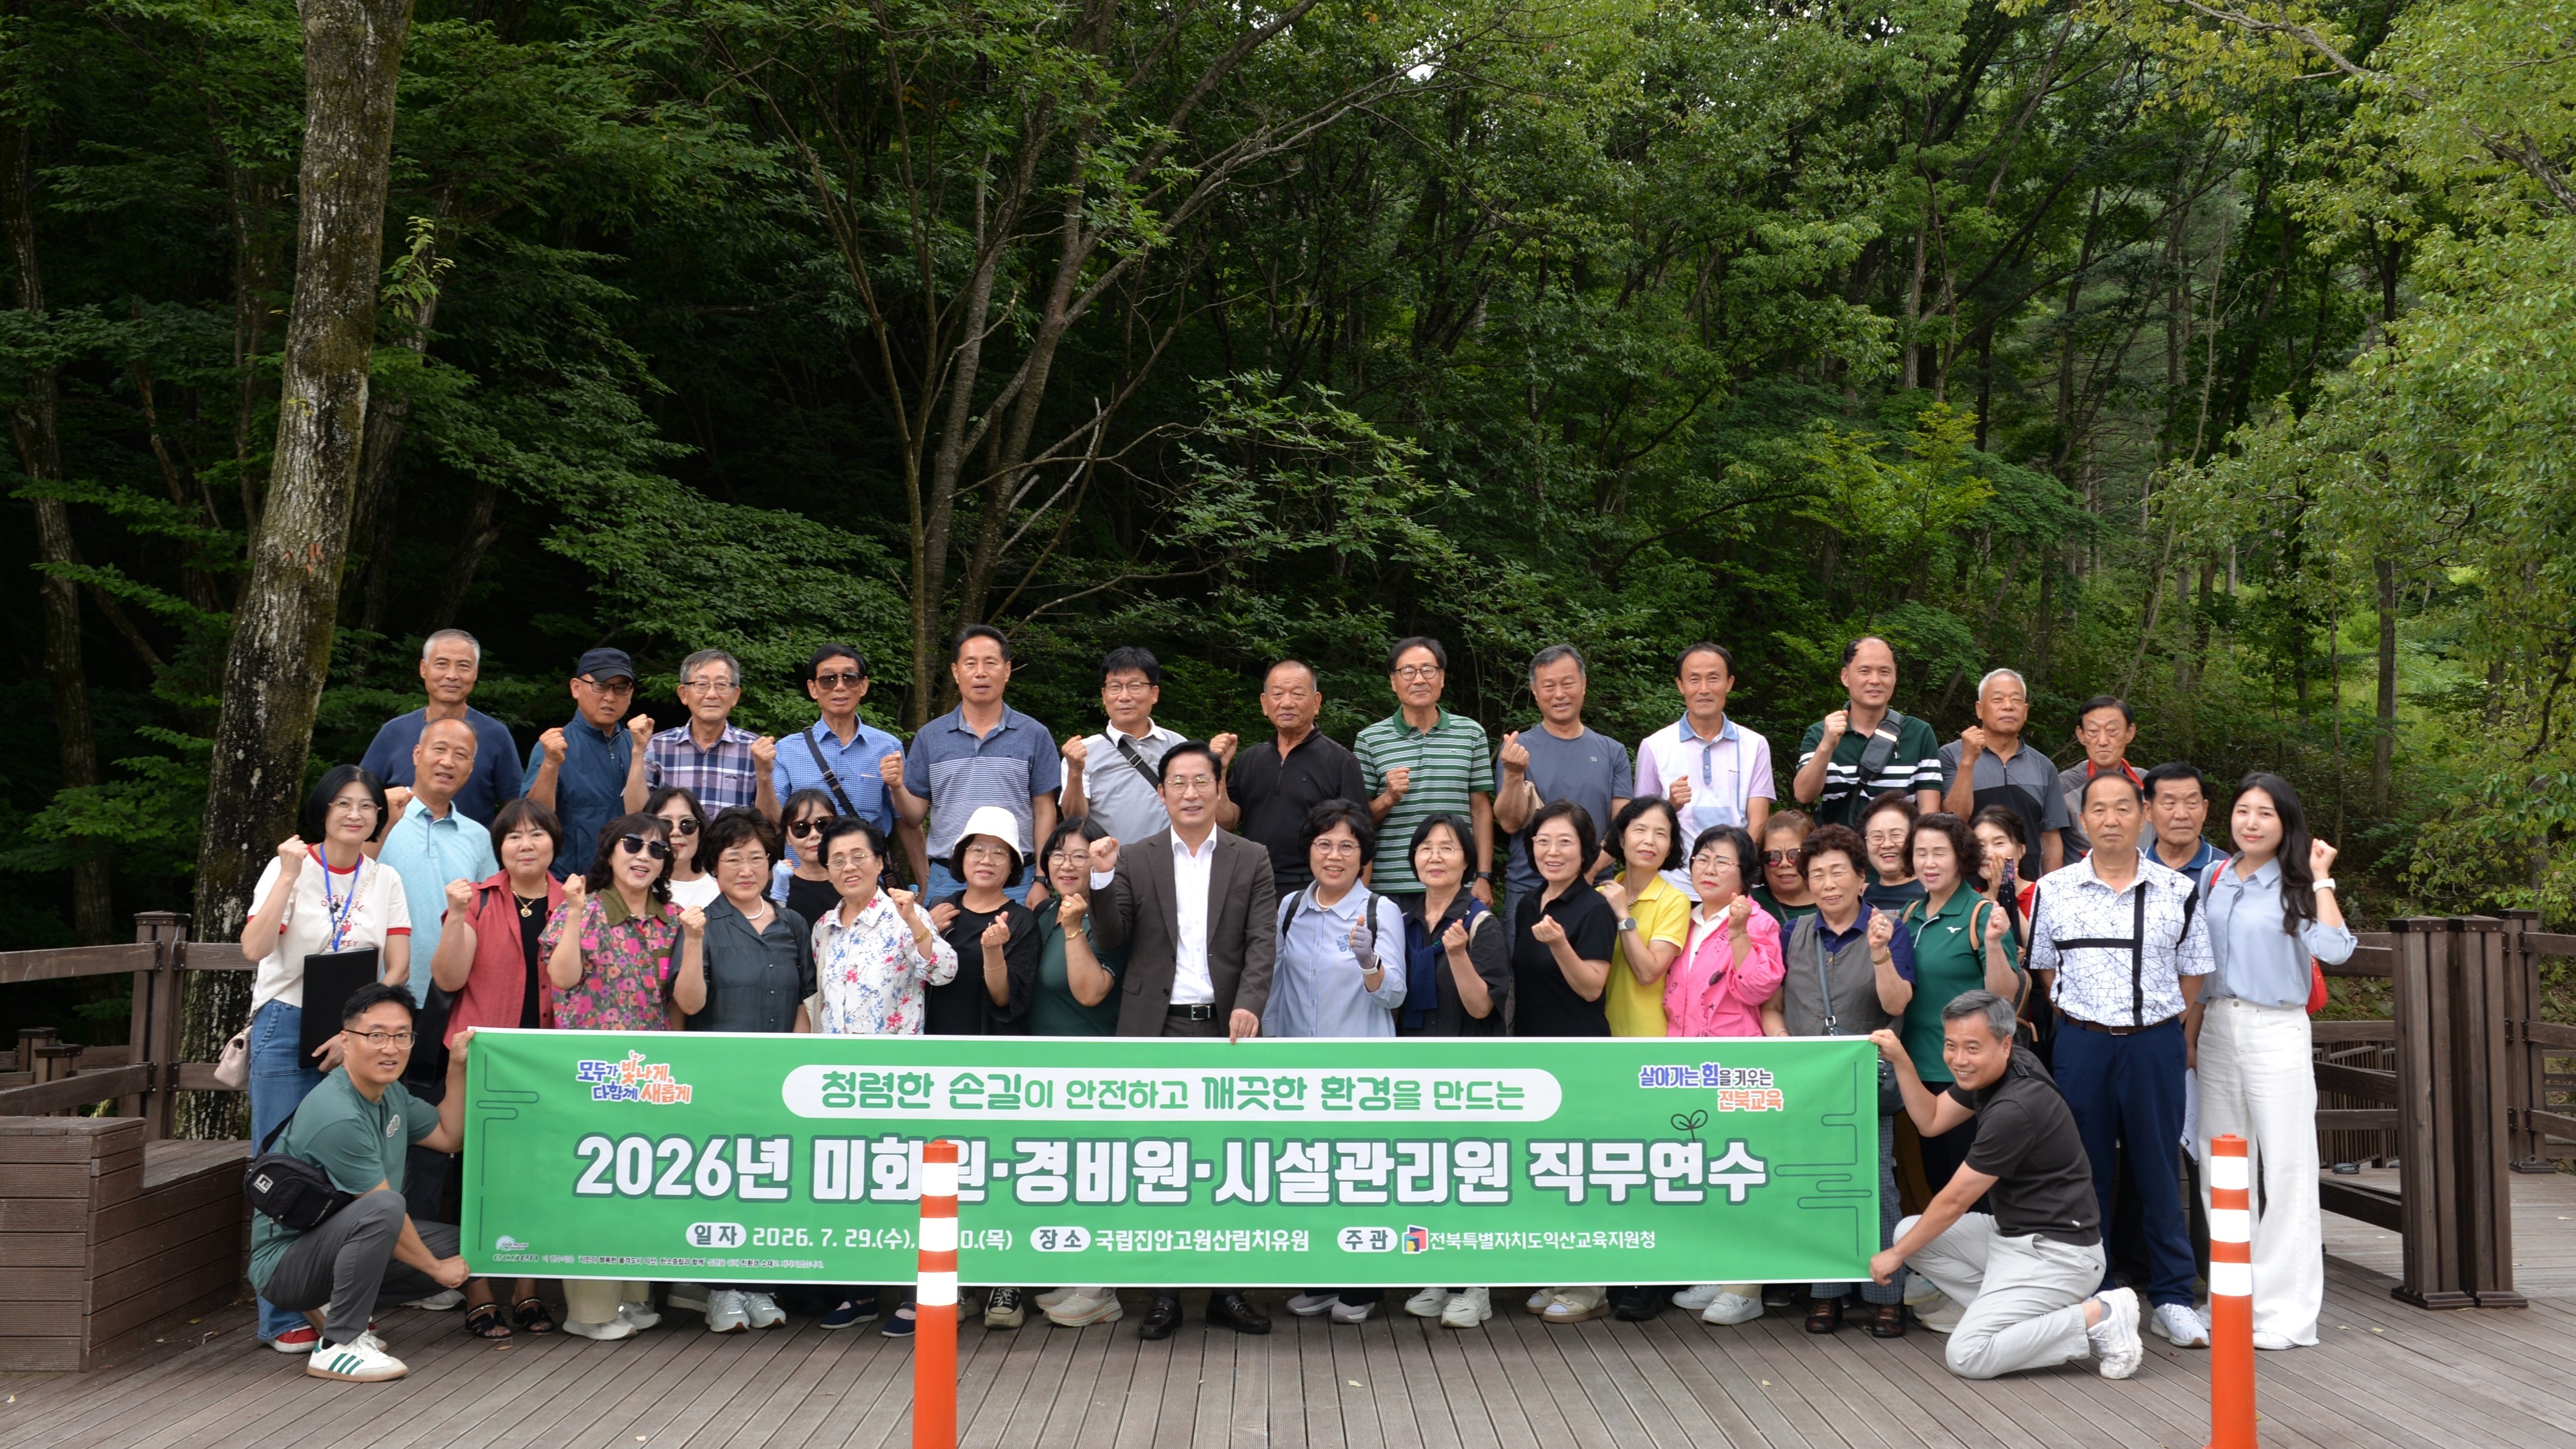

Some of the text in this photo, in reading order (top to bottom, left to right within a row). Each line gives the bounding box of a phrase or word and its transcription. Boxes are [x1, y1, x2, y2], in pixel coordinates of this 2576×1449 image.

[576, 1059, 669, 1086] 모두가 빛나게
[1640, 1063, 1772, 1087] 살아가는 힘을 키우는
[593, 1081, 691, 1103] 다함께 새롭게
[821, 1070, 1526, 1111] 청렴한 손길이 안전하고 깨끗한 환경을 만드는
[1718, 1089, 1783, 1111] 전북교육
[575, 1134, 791, 1200] 2026년
[1529, 1141, 1767, 1203] 직무연수
[753, 1228, 814, 1247] 2026.
[821, 1228, 838, 1247] 7.
[960, 1229, 1013, 1251] 0.(목)
[1094, 1229, 1309, 1252] 국립진안고원산림치유원
[1429, 1230, 1656, 1250] 전북특별자치도익산교육지원청
[599, 1256, 617, 1265] 행복한
[741, 1259, 759, 1267] 친환경
